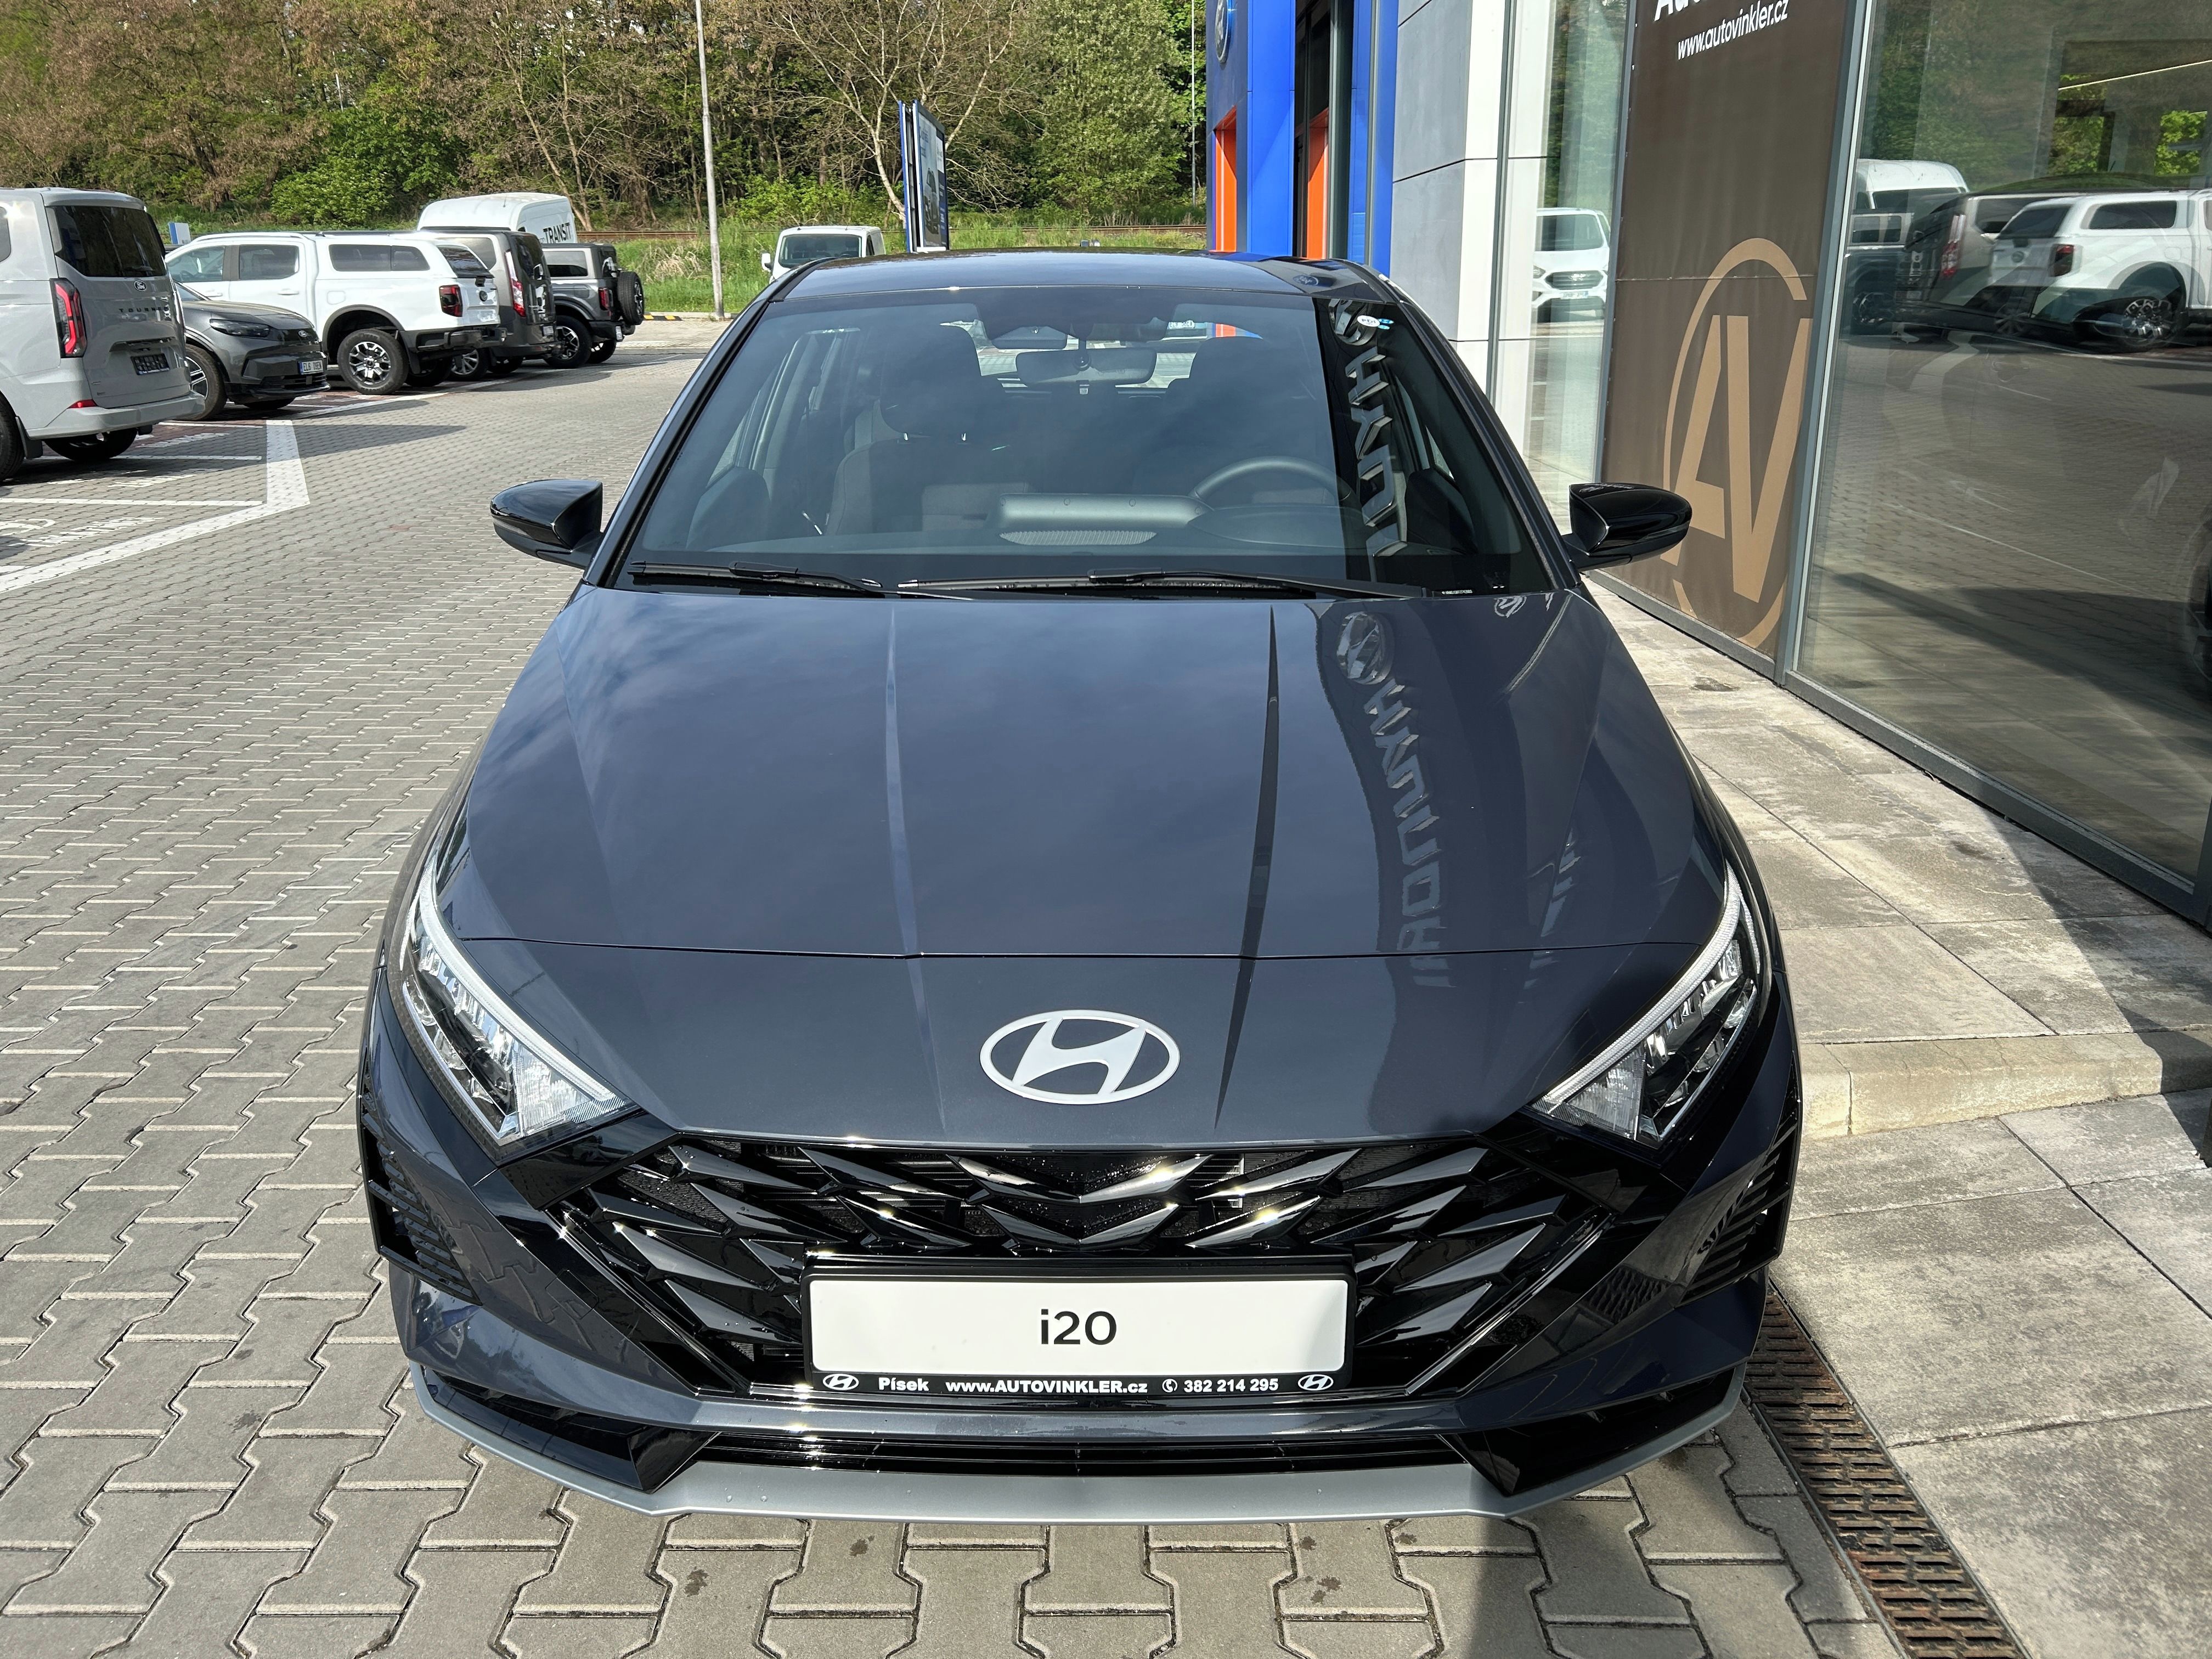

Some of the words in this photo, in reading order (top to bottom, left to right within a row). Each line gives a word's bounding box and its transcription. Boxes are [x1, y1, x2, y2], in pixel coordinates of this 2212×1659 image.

[1678, 0, 1788, 60] www.autovinkler.cz
[543, 222, 571, 244] TRANSIT
[1041, 1309, 1116, 1345] i20
[879, 1378, 929, 1393] Písek
[946, 1380, 1147, 1393] www.AUTOVINKLER.cz
[1184, 1380, 1212, 1392] 382
[1217, 1379, 1245, 1391] 214
[1250, 1379, 1278, 1391] 295
